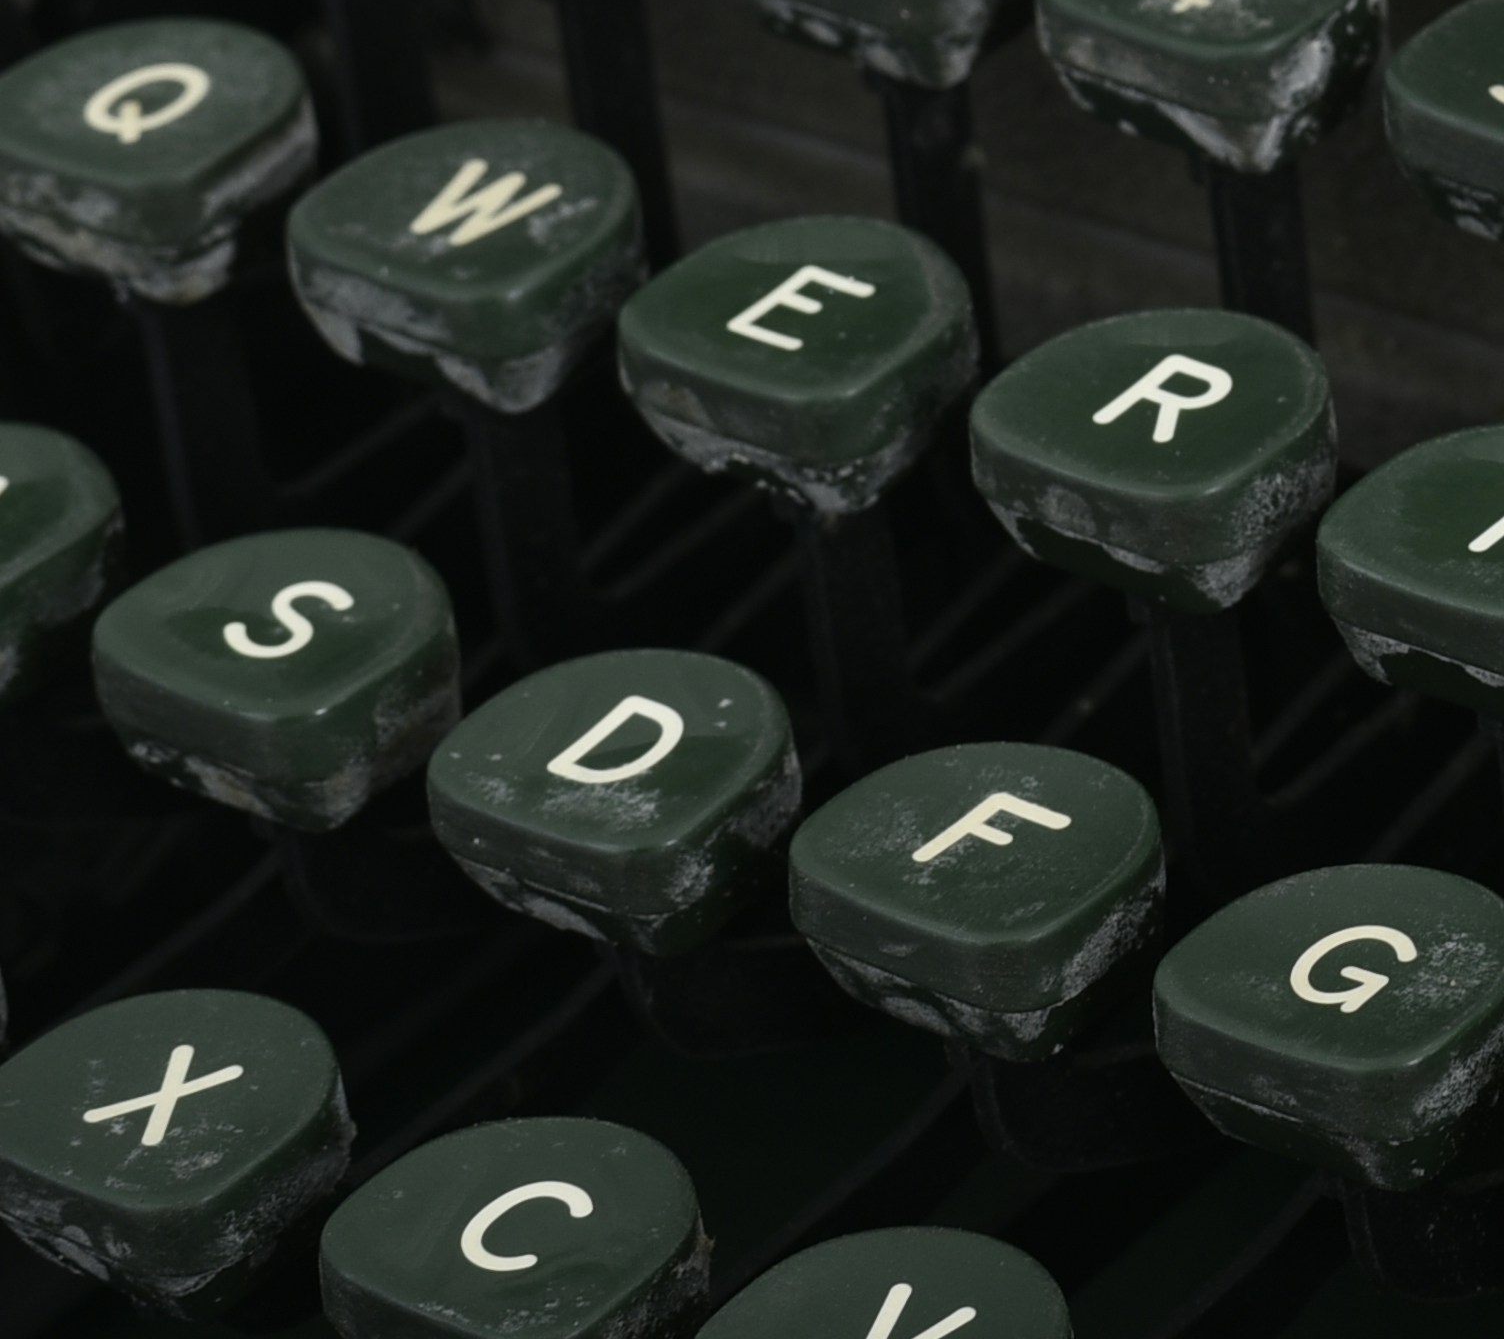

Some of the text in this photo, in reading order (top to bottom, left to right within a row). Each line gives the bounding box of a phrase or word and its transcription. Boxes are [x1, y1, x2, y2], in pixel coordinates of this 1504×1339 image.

[83, 62, 211, 144] Q
[409, 158, 562, 247] W
[726, 264, 876, 352] E
[1091, 353, 1234, 444] R
[222, 580, 355, 659] S
[545, 694, 685, 785] D
[910, 790, 1073, 864] F
[1288, 924, 1419, 1014] G
[82, 1043, 245, 1148] X
[459, 1179, 595, 1273] C
